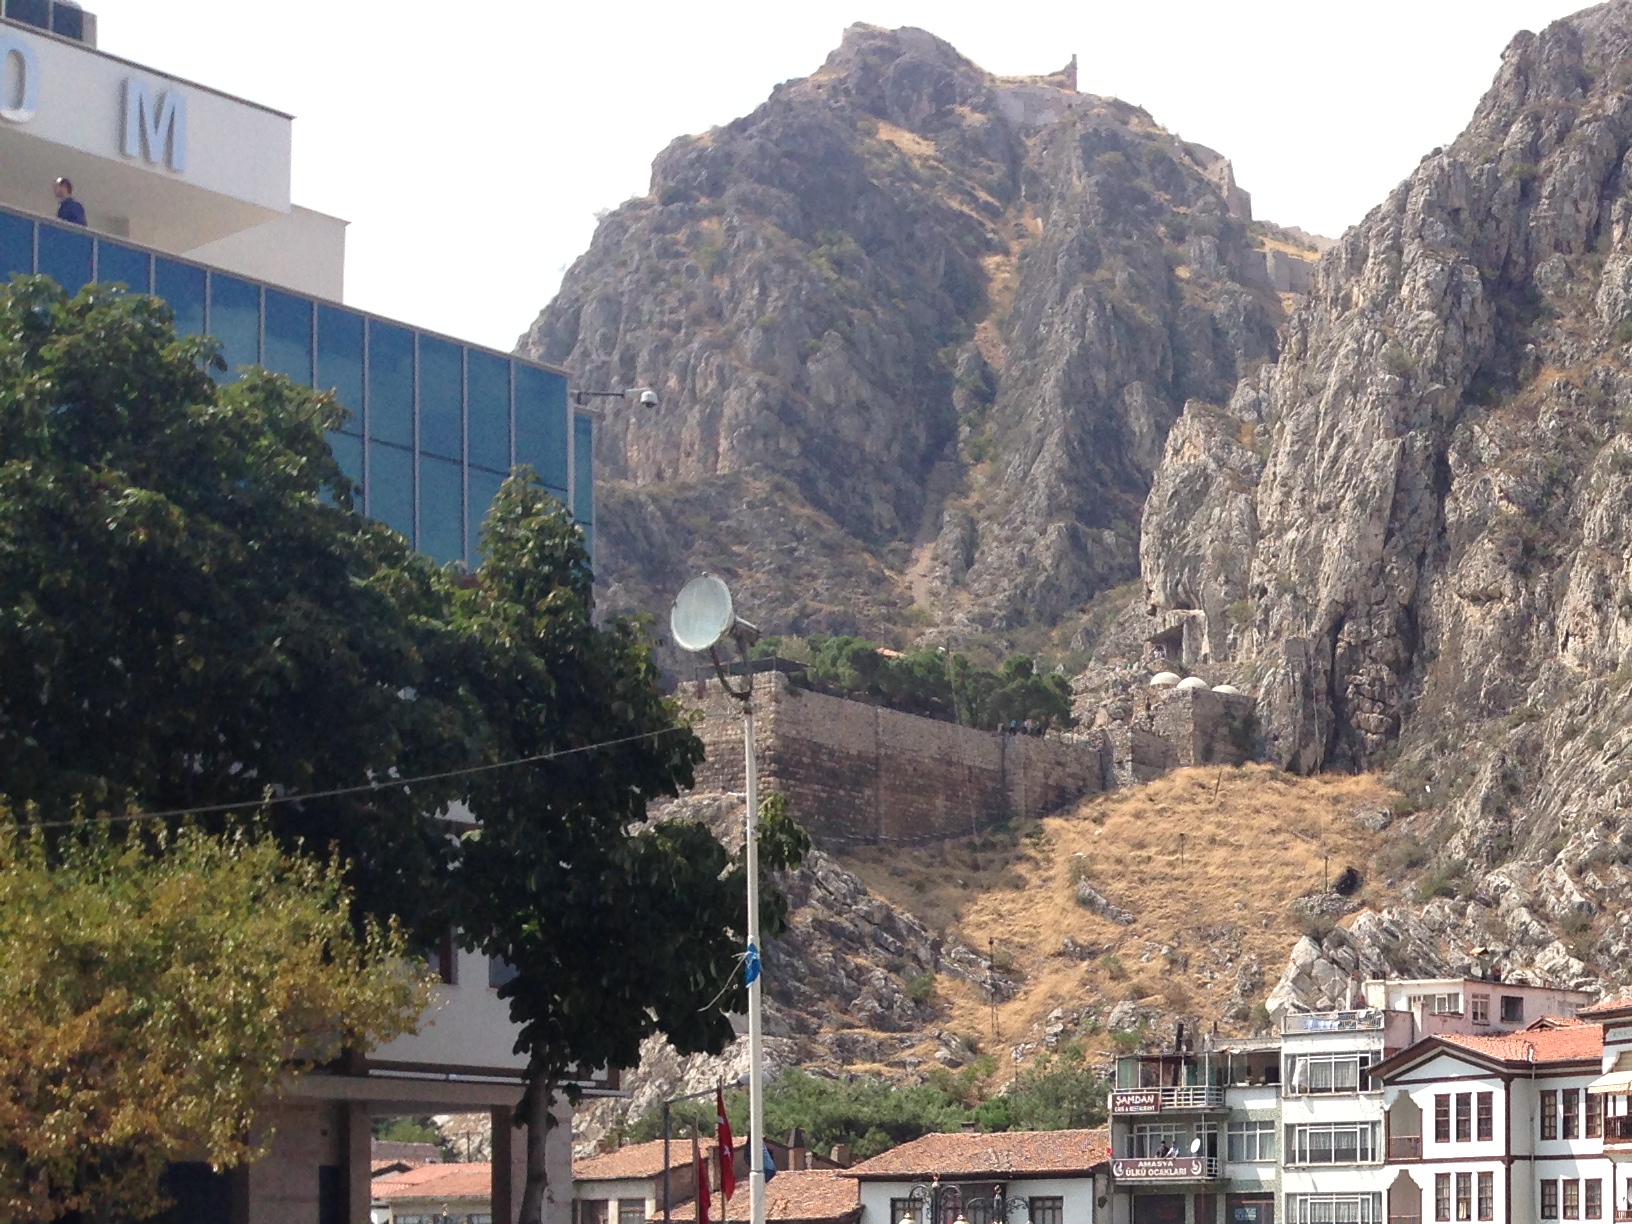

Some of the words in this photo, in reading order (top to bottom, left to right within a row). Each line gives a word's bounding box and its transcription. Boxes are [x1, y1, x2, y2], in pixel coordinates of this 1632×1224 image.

[1116, 1095, 1154, 1106] ŞAMDAN
[1125, 1167, 1147, 1176] ÜLKÜ
[1148, 1168, 1187, 1176] OCAKLARI
